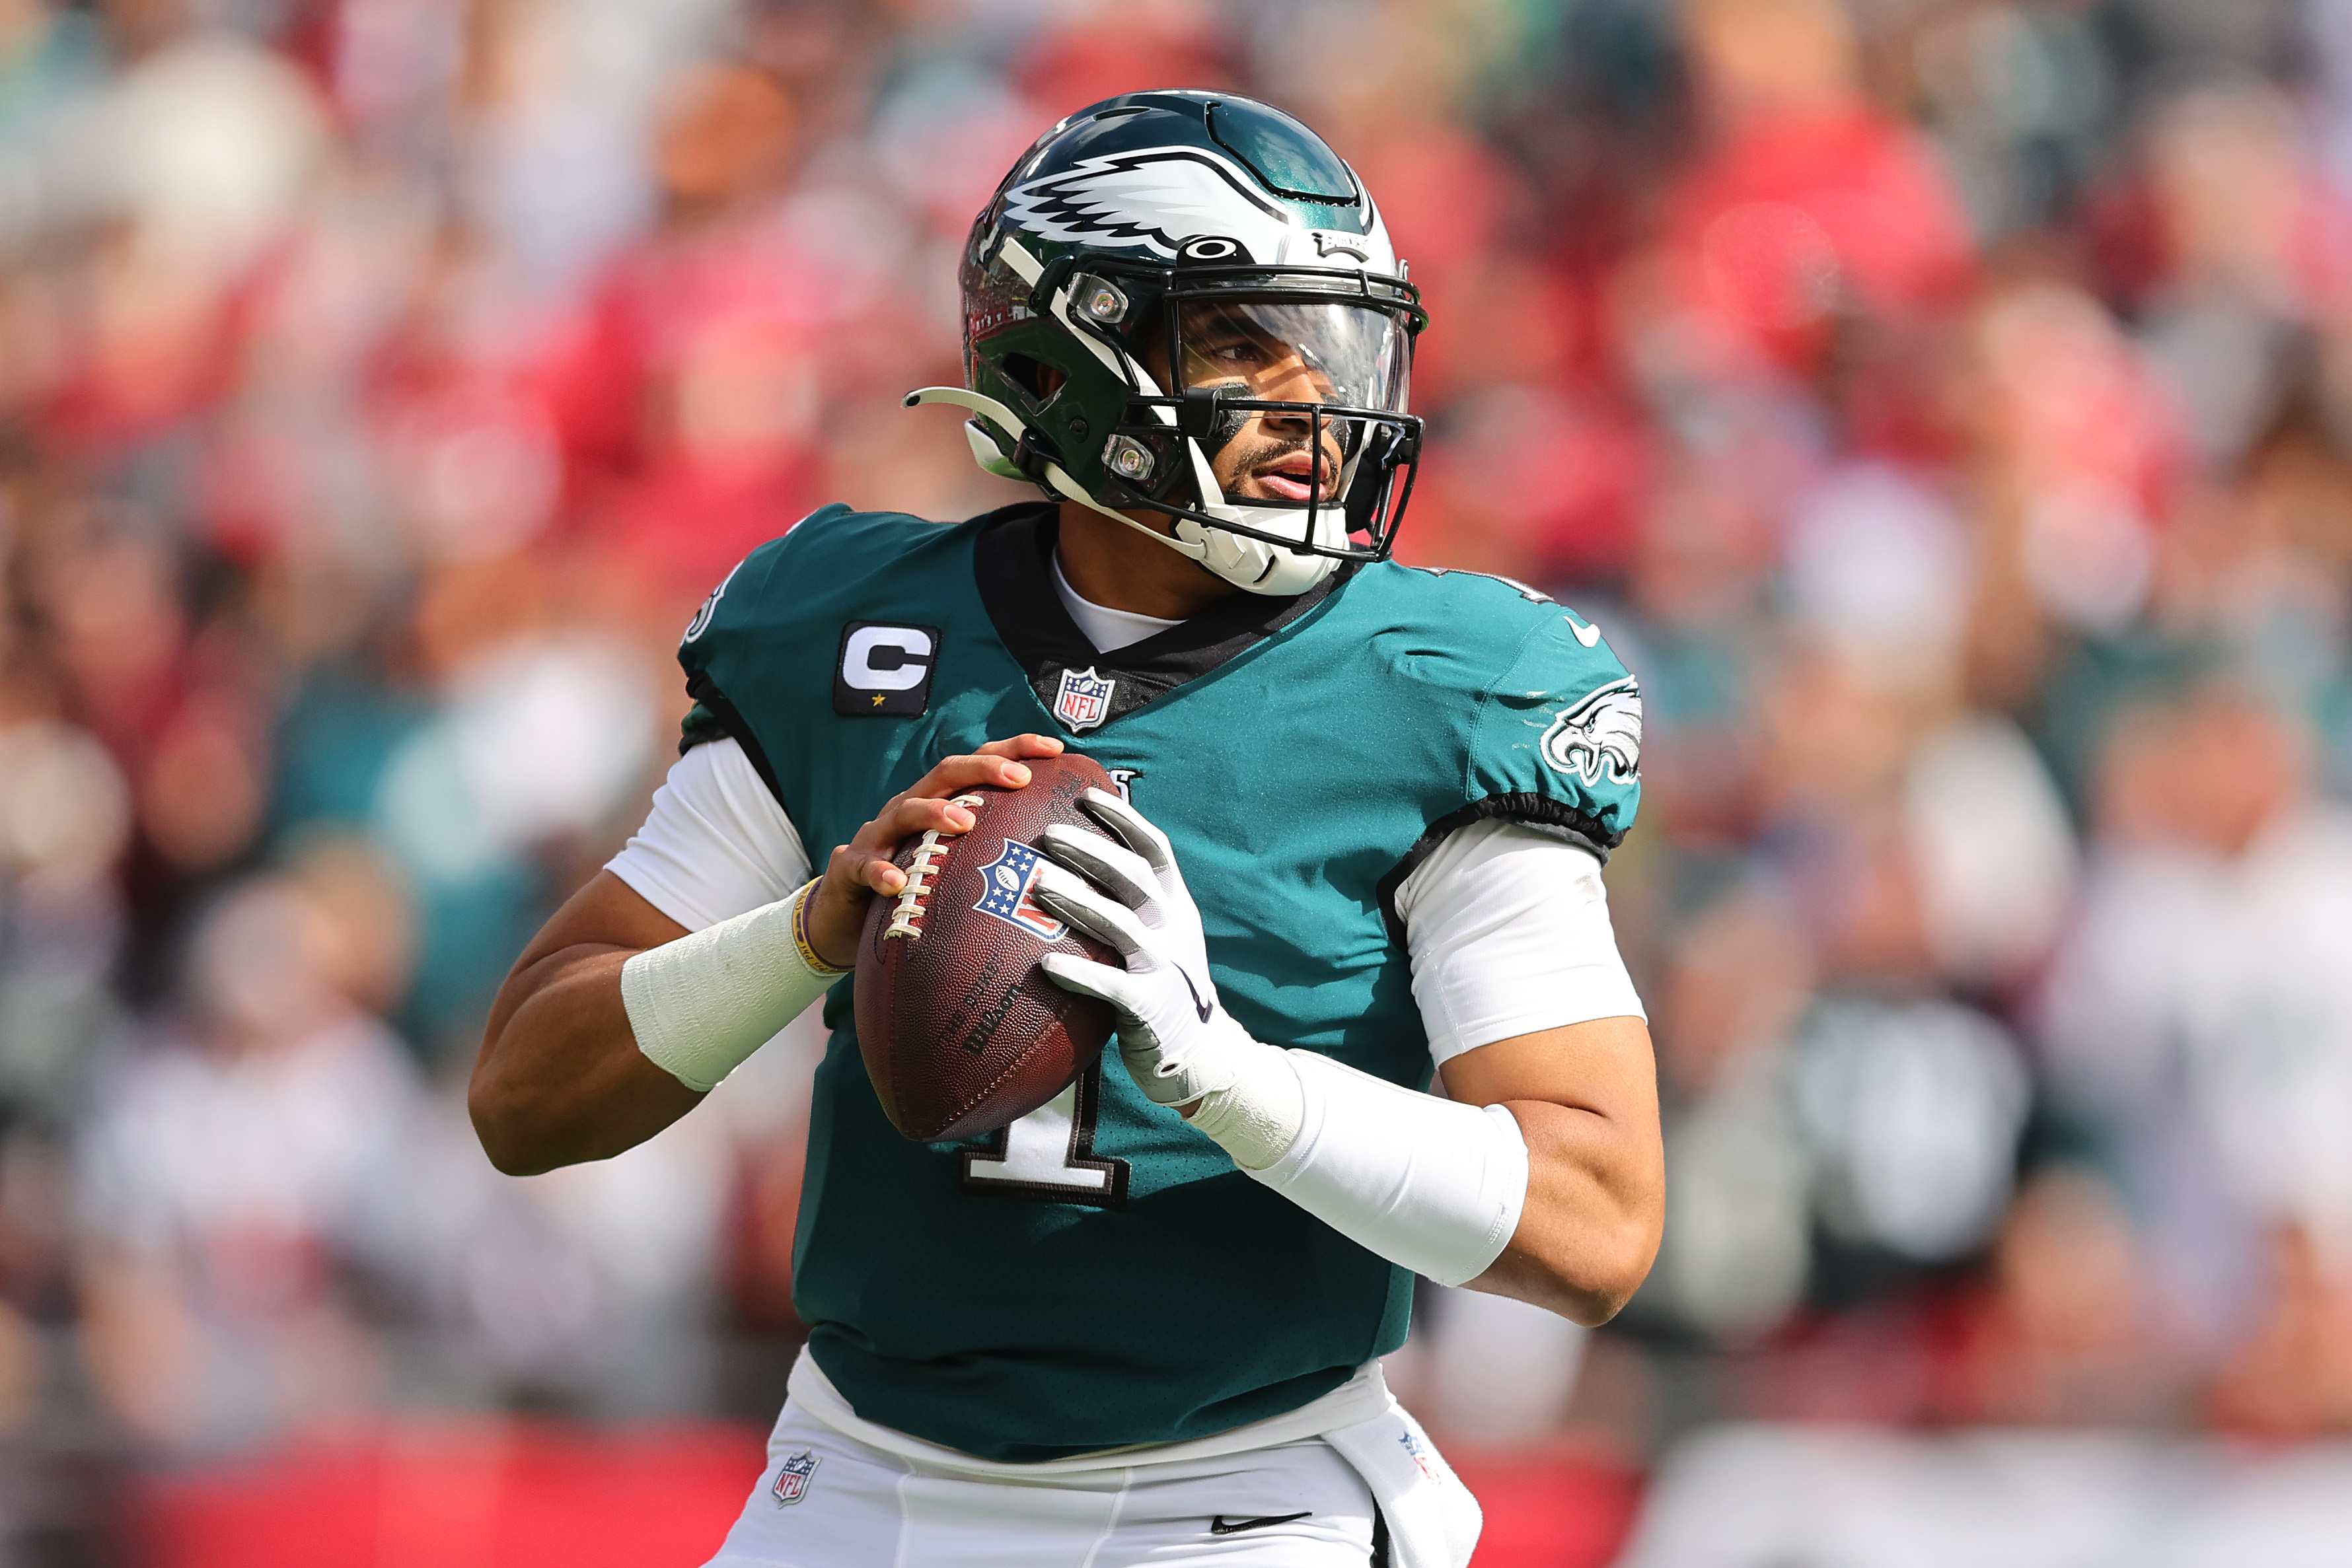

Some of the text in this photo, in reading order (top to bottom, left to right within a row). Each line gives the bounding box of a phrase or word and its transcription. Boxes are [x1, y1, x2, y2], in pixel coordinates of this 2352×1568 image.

[842, 626, 932, 691] C
[1062, 693, 1097, 721] NFL
[961, 984, 1023, 1056] Wilson
[775, 1472, 803, 1497] NFL
